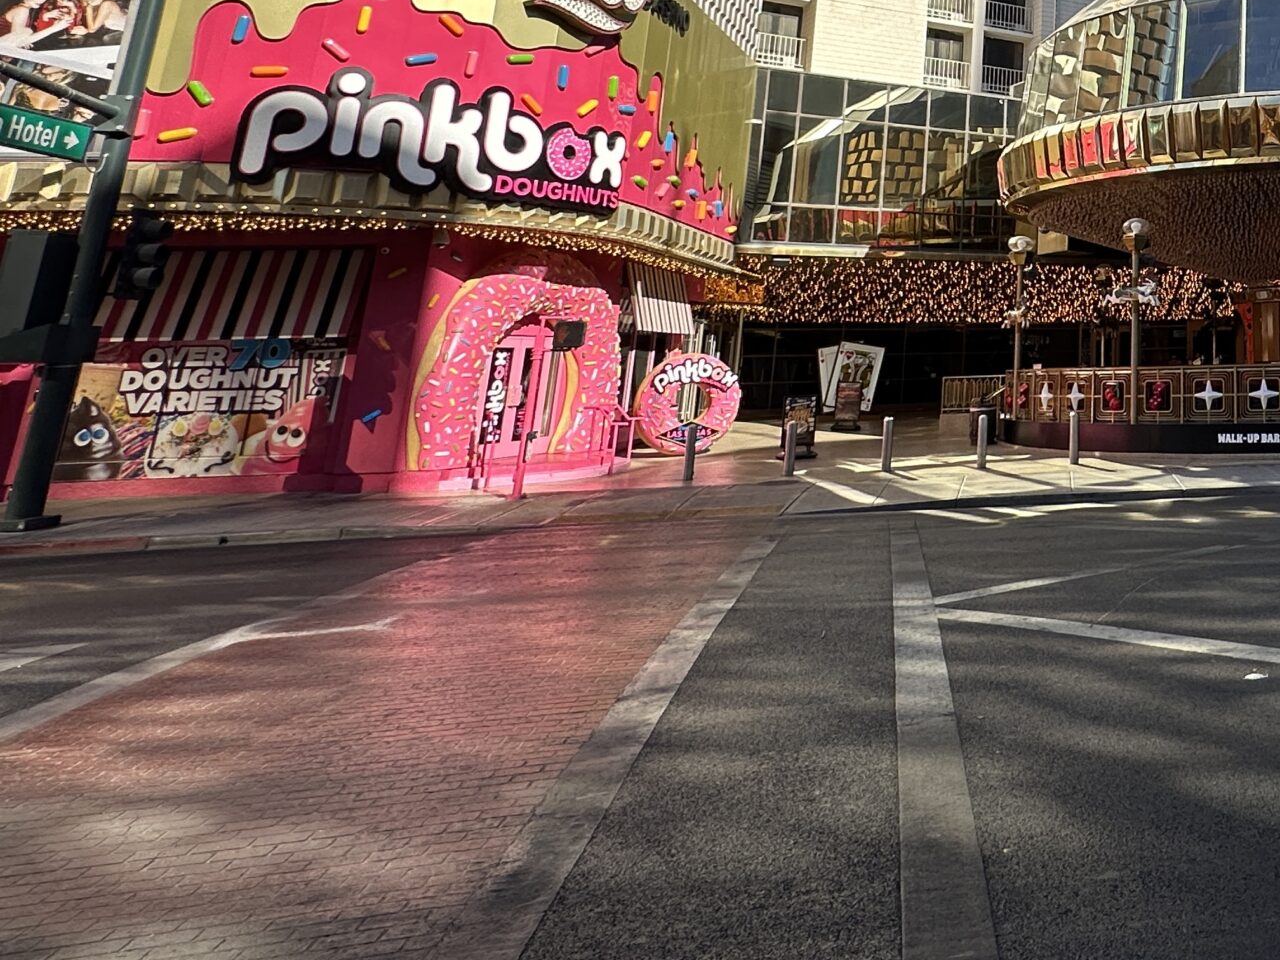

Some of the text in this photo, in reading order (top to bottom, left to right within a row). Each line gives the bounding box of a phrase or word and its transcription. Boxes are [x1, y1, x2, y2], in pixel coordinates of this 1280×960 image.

[7, 114, 60, 148] Hotel
[238, 72, 627, 193] pinkbox
[495, 174, 620, 209] DOUGHNUTS
[142, 340, 291, 370] OVER 70
[119, 368, 298, 392] DOUGHNUT
[653, 359, 738, 393] pinkbox
[126, 389, 284, 414] VARIETIES
[667, 430, 682, 438] LAS
[1217, 433, 1280, 443] WALK-UP BAR
